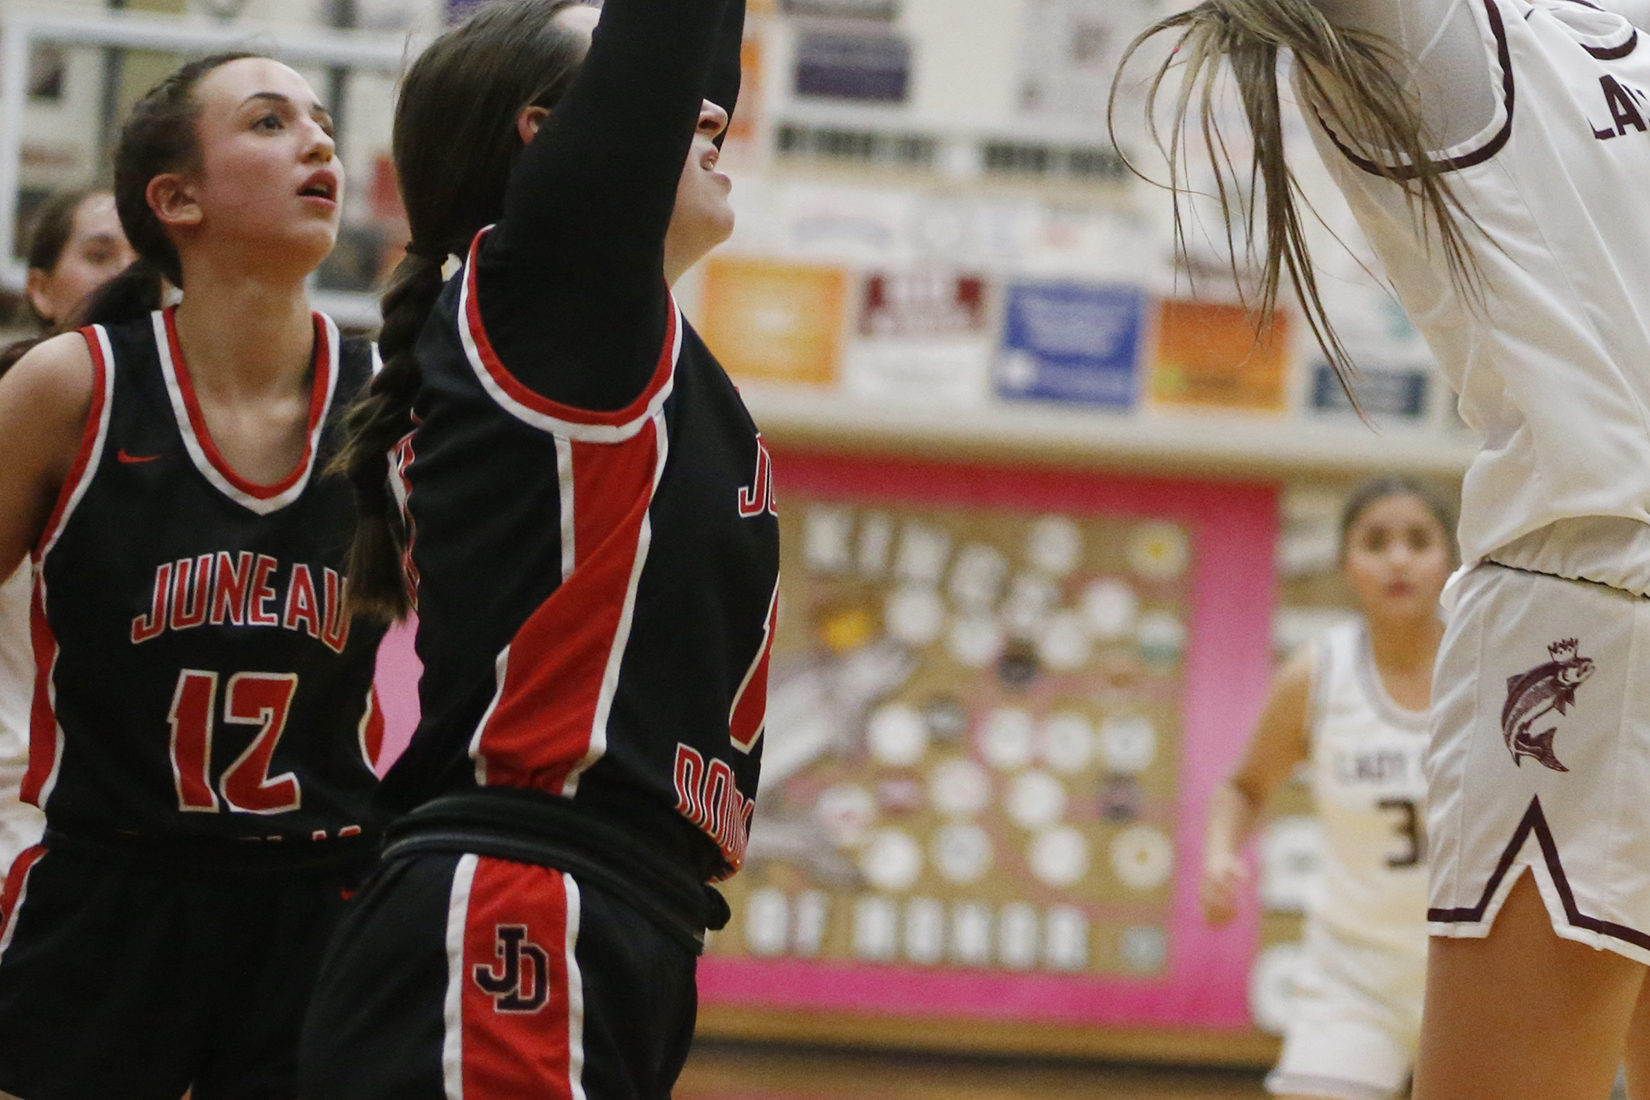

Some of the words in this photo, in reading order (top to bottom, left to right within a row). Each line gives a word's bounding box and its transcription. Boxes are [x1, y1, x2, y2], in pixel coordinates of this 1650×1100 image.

[130, 550, 352, 655] JUNEAU
[166, 668, 301, 815] 12
[472, 923, 551, 1015] JD
